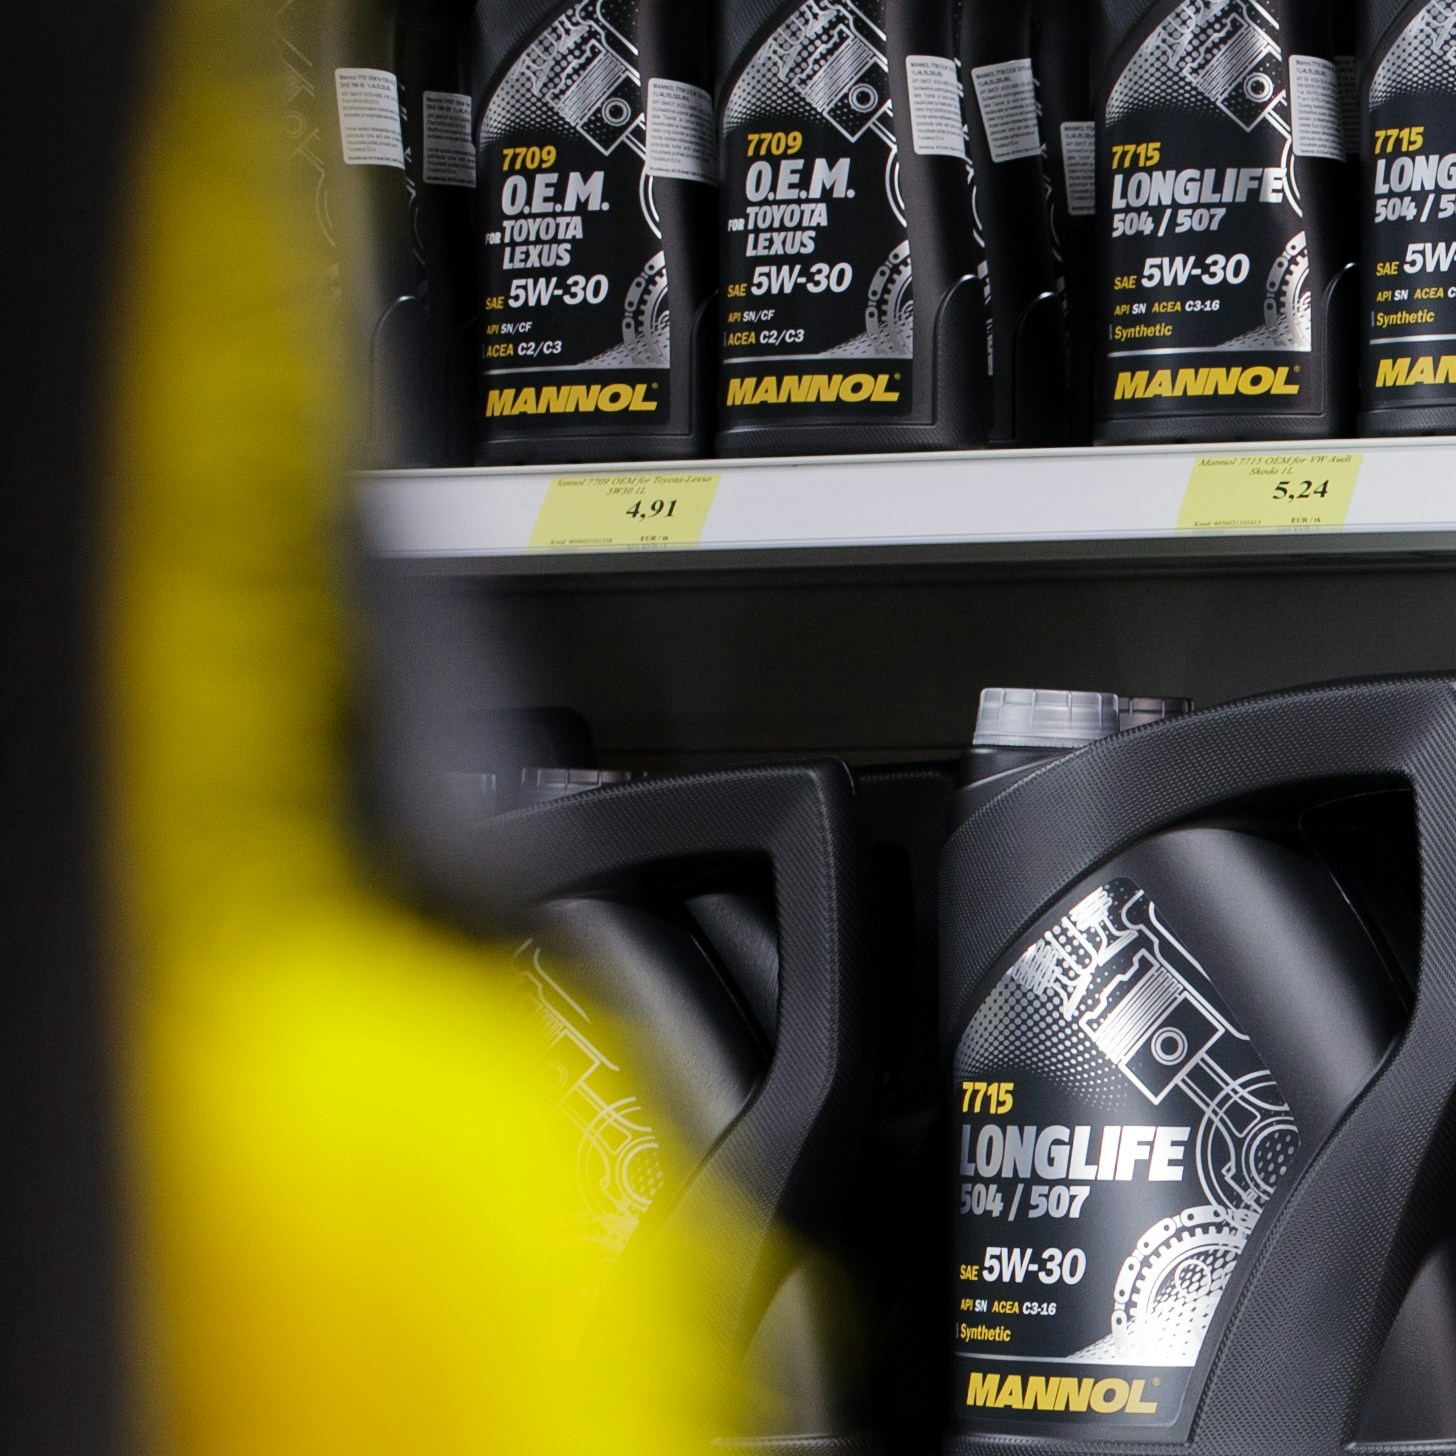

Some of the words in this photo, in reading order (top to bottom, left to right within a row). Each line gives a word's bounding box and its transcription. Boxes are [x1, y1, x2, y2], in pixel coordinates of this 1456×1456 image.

[747, 131, 802, 157] 7709
[1374, 126, 1424, 154] 7715
[503, 145, 557, 171] 7709
[1111, 141, 1161, 169] 7715
[502, 171, 610, 216] O.E.M.
[746, 157, 855, 202] O.E.M.
[1111, 167, 1287, 210] LONGLIFE
[485, 232, 502, 245] FOR
[502, 216, 583, 244] TOYOTA
[728, 218, 745, 232] FOR
[746, 203, 828, 230] TOYOTA
[502, 243, 571, 270] LEXUS
[746, 230, 816, 257] LEXUS
[727, 283, 747, 298] SAE
[751, 262, 853, 296] 5W-30
[1114, 275, 1137, 290] SAE
[1141, 253, 1250, 288] 5W-30
[1376, 261, 1399, 276] SAE
[485, 297, 504, 310] SAE
[508, 274, 609, 308] 5W-30
[728, 331, 755, 346] ACEA
[759, 329, 804, 346] C2/C3
[726, 373, 900, 407] MANNOL
[1114, 366, 1300, 400] MANNOL
[486, 383, 657, 417] MANNOL
[1272, 479, 1329, 504] 5,24
[625, 499, 678, 522] 4,91
[962, 1081, 1014, 1114] 7715
[960, 1124, 1191, 1182] LONGLIFE
[960, 1264, 979, 1281] SAE
[982, 1246, 1087, 1285] 5W-30
[960, 1298, 973, 1311] API
[974, 1299, 987, 1313] SN
[991, 1300, 1020, 1314] ACEA
[1022, 1301, 1057, 1316] C3-16
[960, 1323, 1012, 1343] Synthetic
[966, 1372, 1159, 1414] MANNOL
